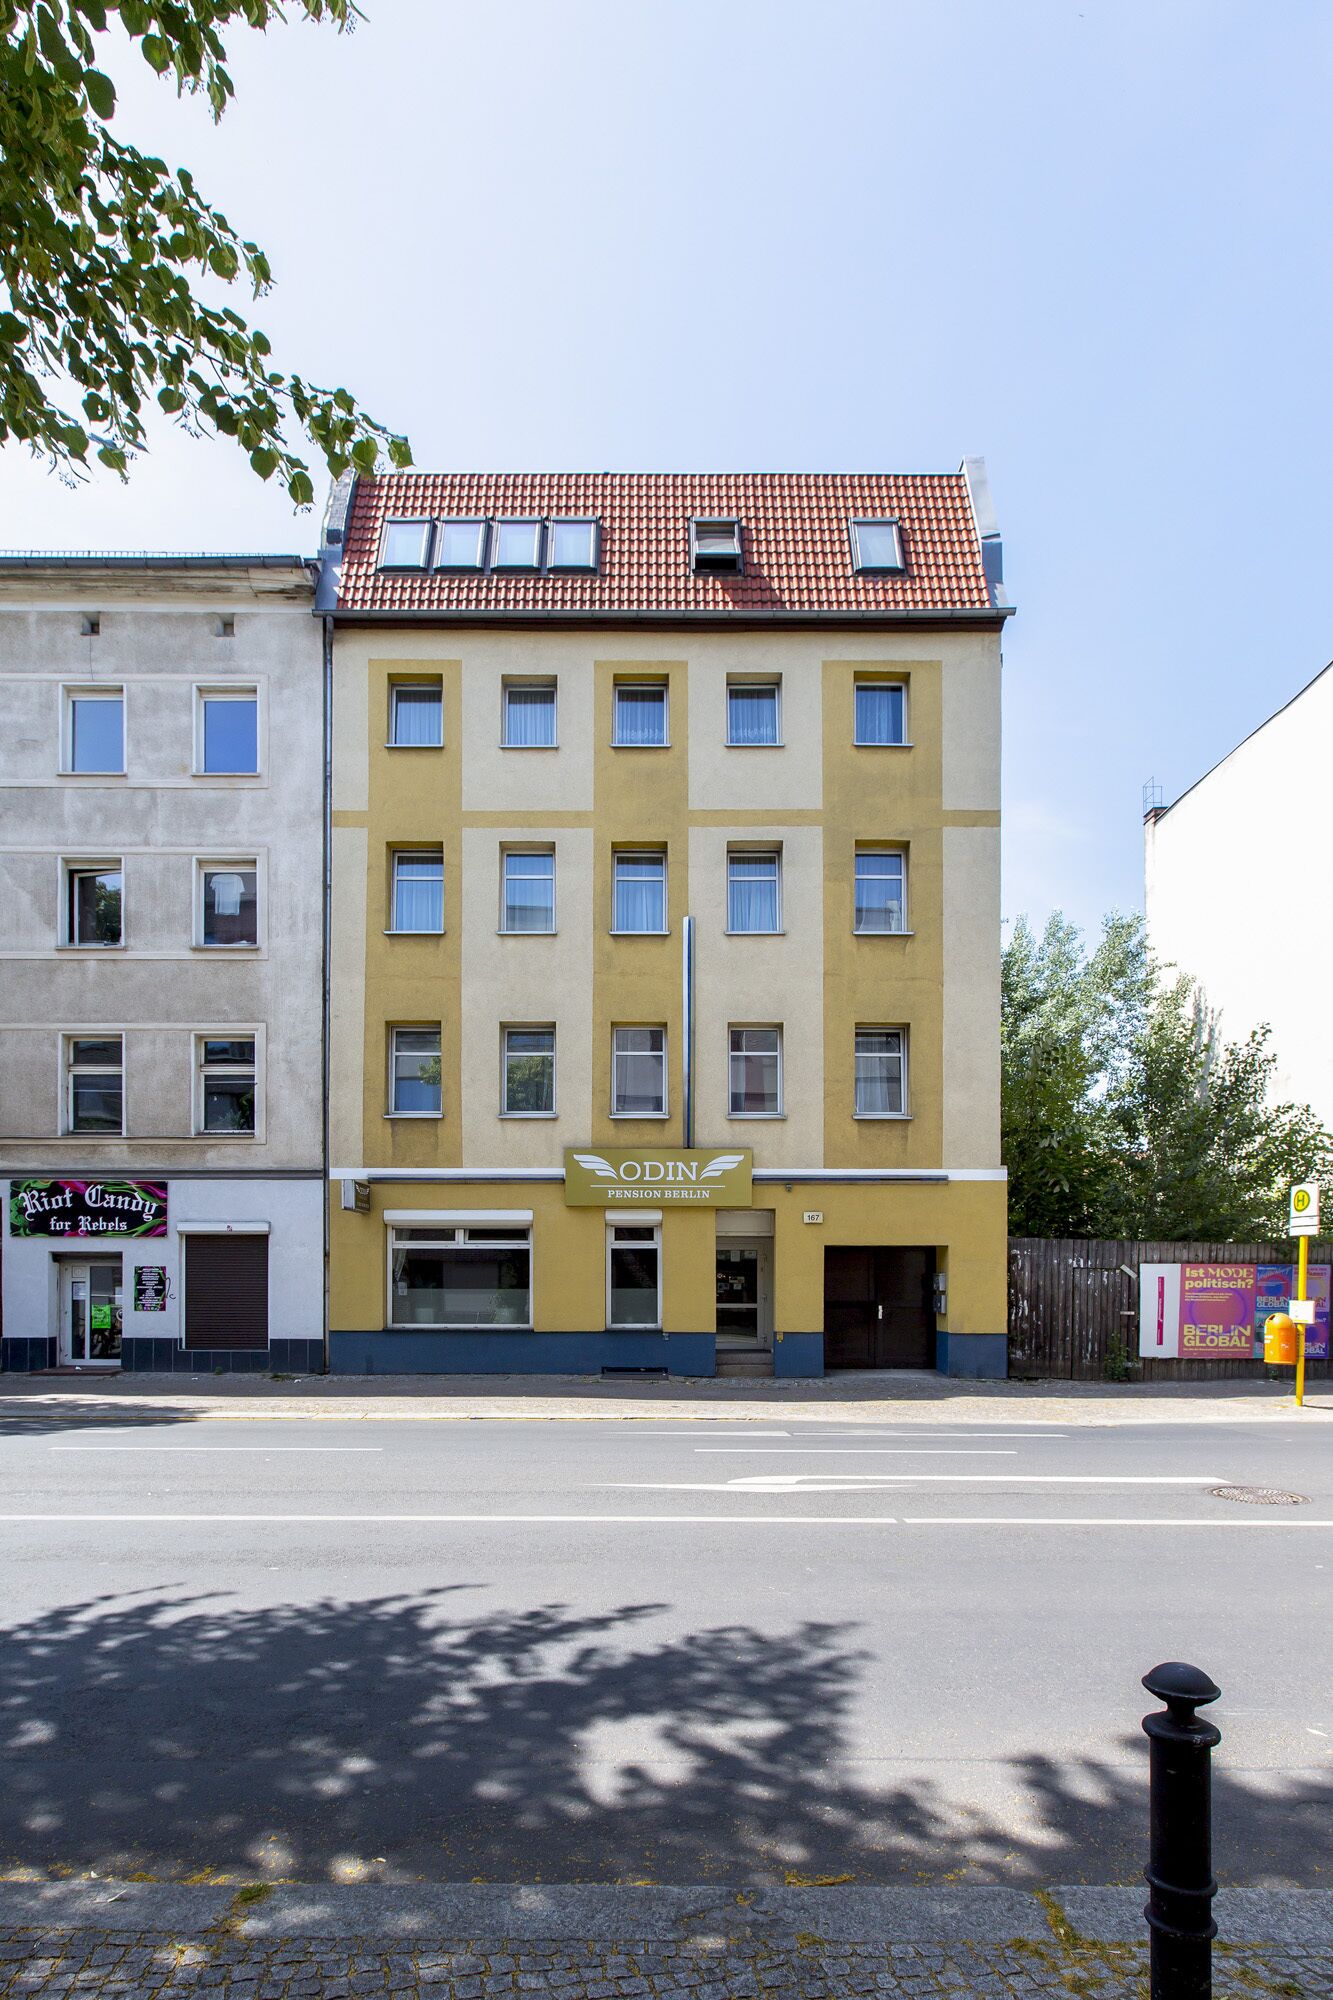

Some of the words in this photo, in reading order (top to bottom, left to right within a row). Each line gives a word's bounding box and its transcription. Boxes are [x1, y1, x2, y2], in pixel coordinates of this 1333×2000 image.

[619, 1161, 698, 1181] ODIN
[607, 1189, 662, 1199] PENSION
[664, 1190, 710, 1199] BERLIN
[18, 1187, 73, 1221] Riot
[84, 1184, 158, 1222] Candy
[50, 1216, 71, 1231] for
[78, 1215, 128, 1236] Rebels
[1185, 1267, 1205, 1278] Ist
[1208, 1267, 1254, 1278] MODE
[1184, 1278, 1254, 1290] politisch?
[1183, 1324, 1251, 1336] BERLIN
[1183, 1335, 1251, 1347] GLOBAL
